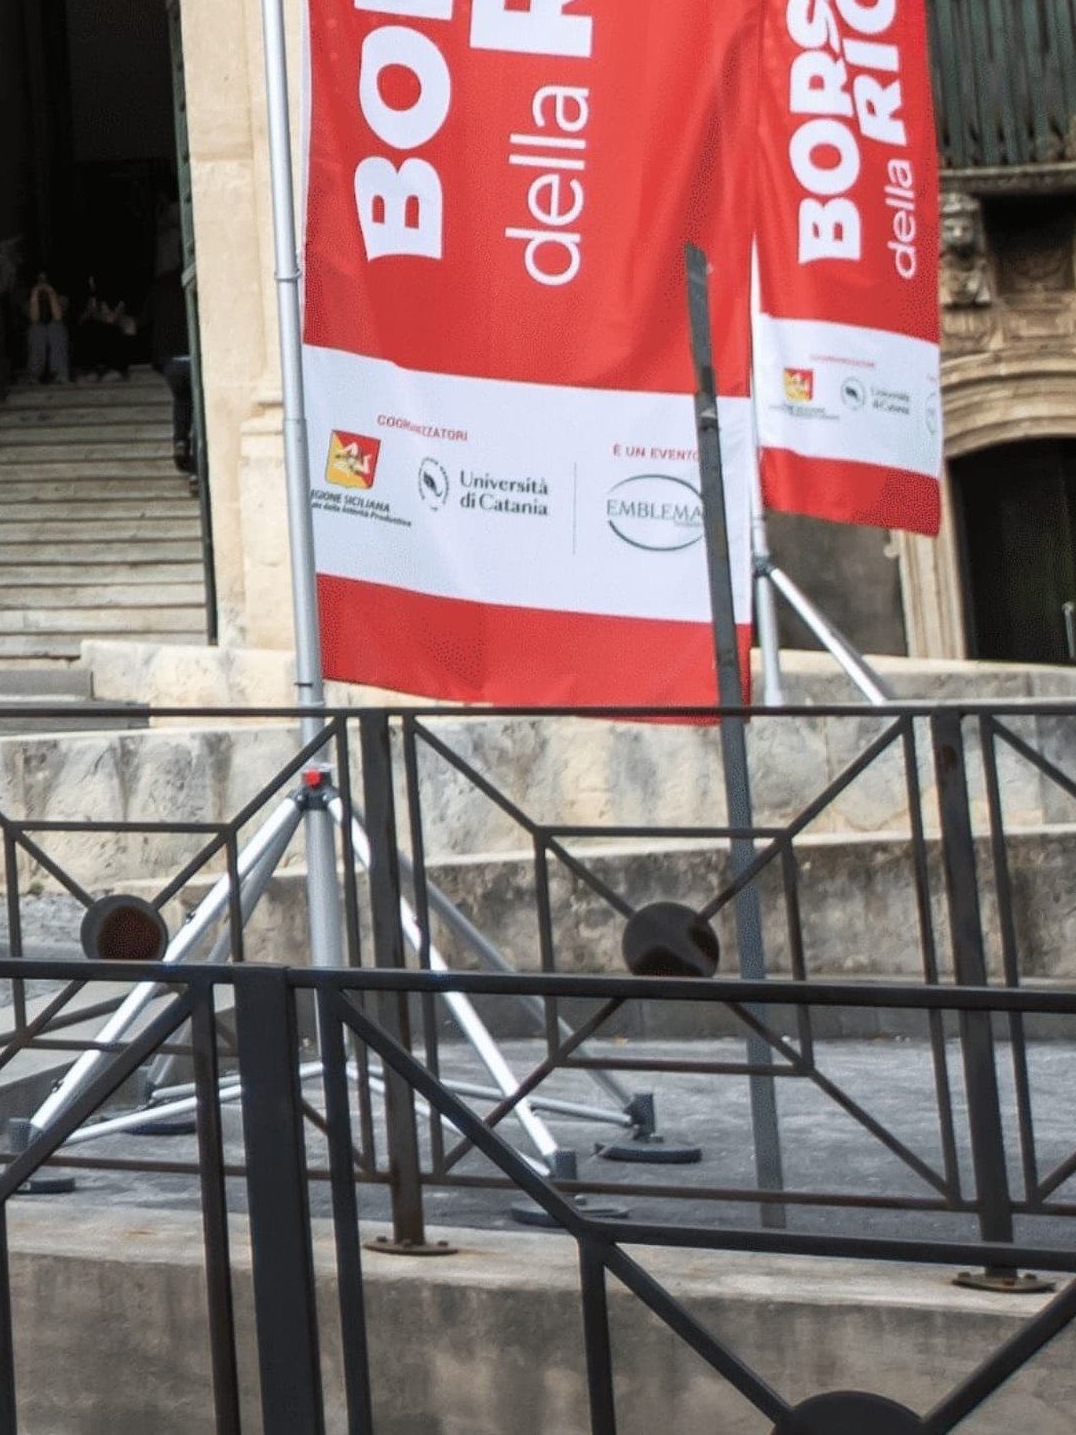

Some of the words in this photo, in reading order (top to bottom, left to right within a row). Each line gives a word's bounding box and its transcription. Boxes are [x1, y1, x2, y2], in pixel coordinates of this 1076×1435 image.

[505, 85, 591, 287] della
[887, 159, 914, 279] della
[626, 447, 645, 457] UN
[460, 470, 549, 496] Università
[460, 492, 476, 509] di
[479, 493, 549, 516] Catania
[607, 499, 702, 522] EMBLEMA
